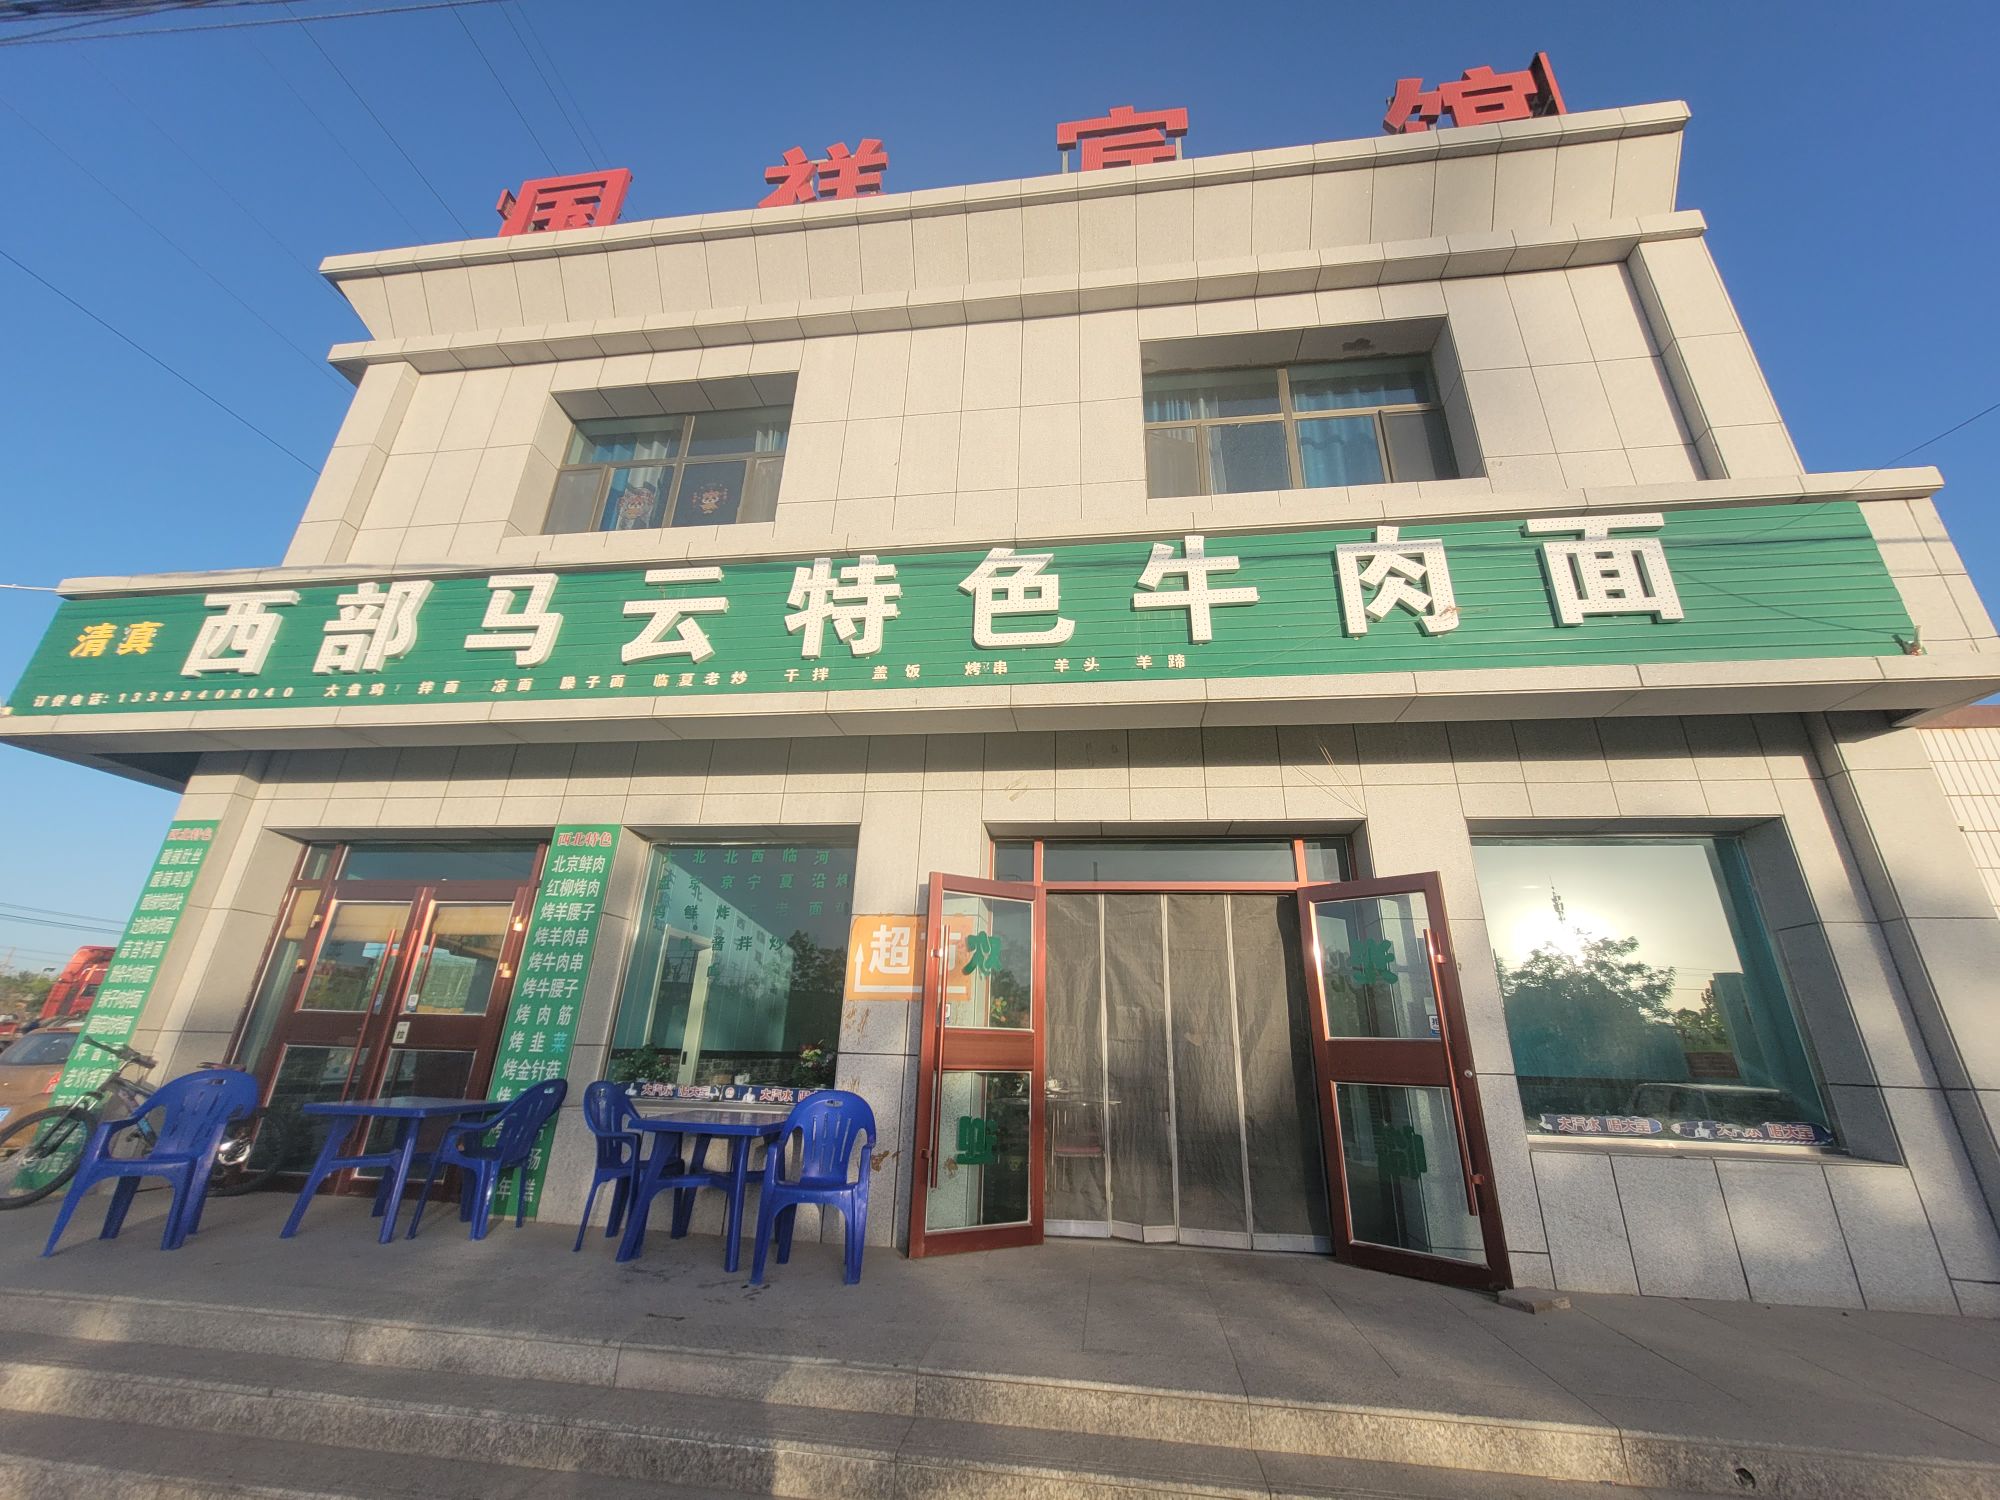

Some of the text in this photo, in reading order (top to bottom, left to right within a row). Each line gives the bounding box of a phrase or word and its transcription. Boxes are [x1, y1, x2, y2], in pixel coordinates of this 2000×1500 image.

[180, 512, 1685, 678] 西部马云特色牛肉面
[69, 621, 165, 657] 清真
[323, 654, 1186, 697] 大盘鸡 拌面 凉面 臊子面 临夏老炒 干拌 盖饭 烤串 羊头 羊蹄
[557, 832, 612, 847] 西北特色
[551, 855, 606, 874] 北京鲜肉
[545, 879, 600, 897] 红柳烤肉
[539, 902, 595, 921] 烤羊腰子
[533, 927, 588, 947] 烤羊肉串
[527, 952, 584, 973] 烤牛肉串
[521, 977, 578, 998] 烤牛腰子
[515, 1004, 574, 1026] 烤肉筋
[509, 1031, 568, 1053] 烤韭菜
[502, 1059, 562, 1081] 烤金针菇
[641, 1083, 673, 1097] 大汽水
[760, 1088, 793, 1103] 大汽水
[1557, 1116, 1602, 1133] 大汽水
